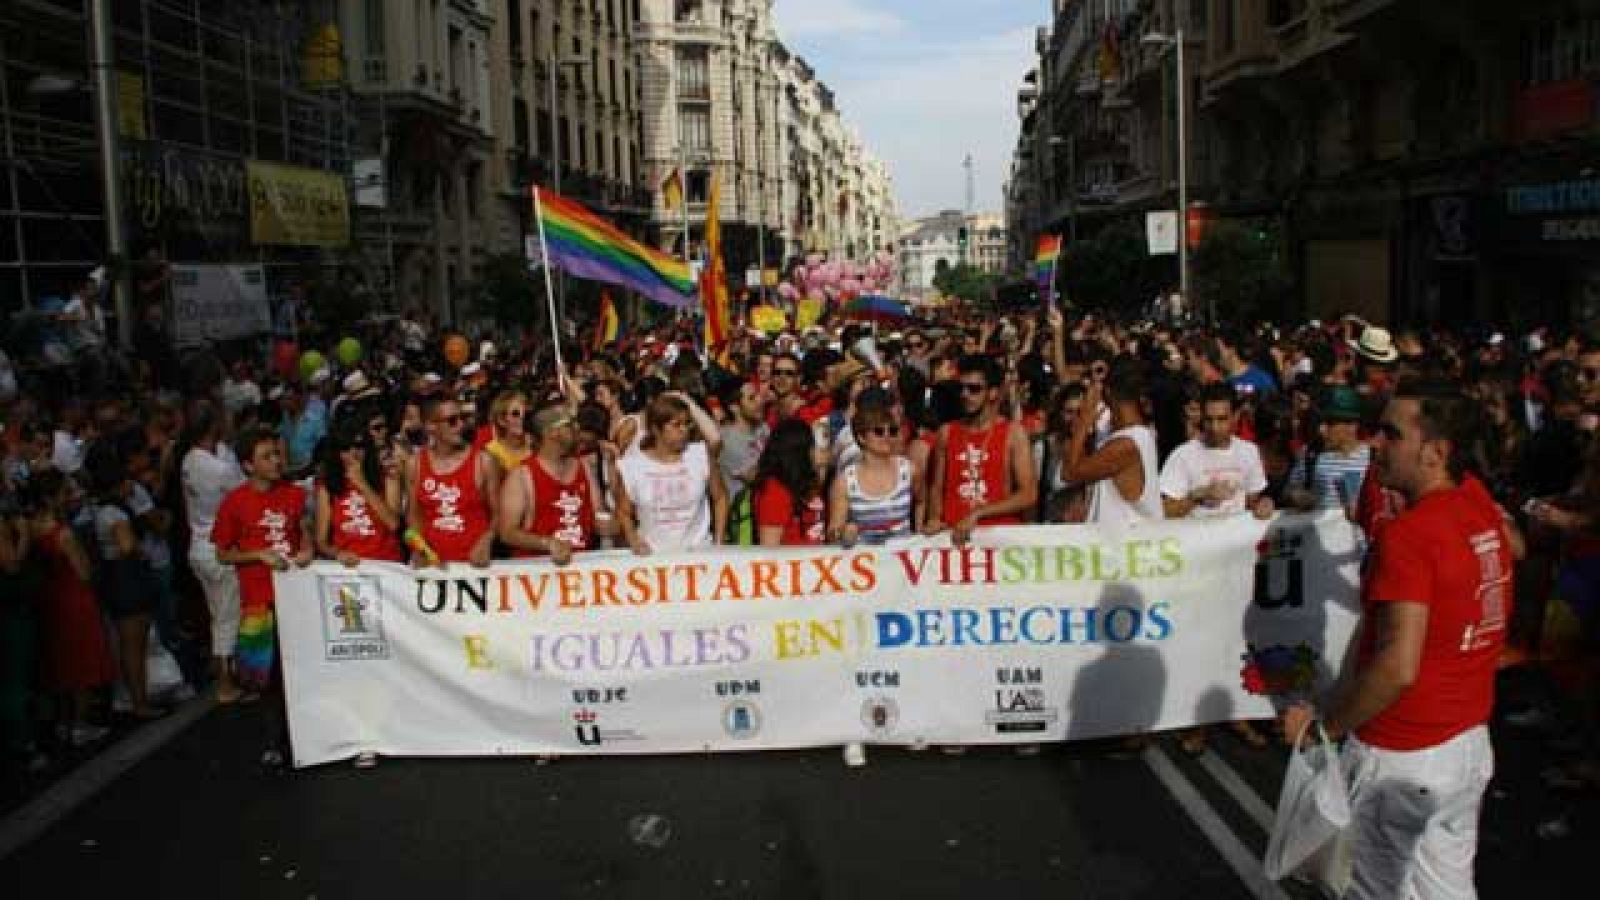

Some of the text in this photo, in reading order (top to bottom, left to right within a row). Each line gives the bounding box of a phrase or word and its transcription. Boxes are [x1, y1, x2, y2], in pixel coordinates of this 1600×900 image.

[415, 538, 1184, 613] UNIVERSITARIXS VIHSIBLES
[462, 601, 1174, 671] E IGUALES EN DERECHOS
